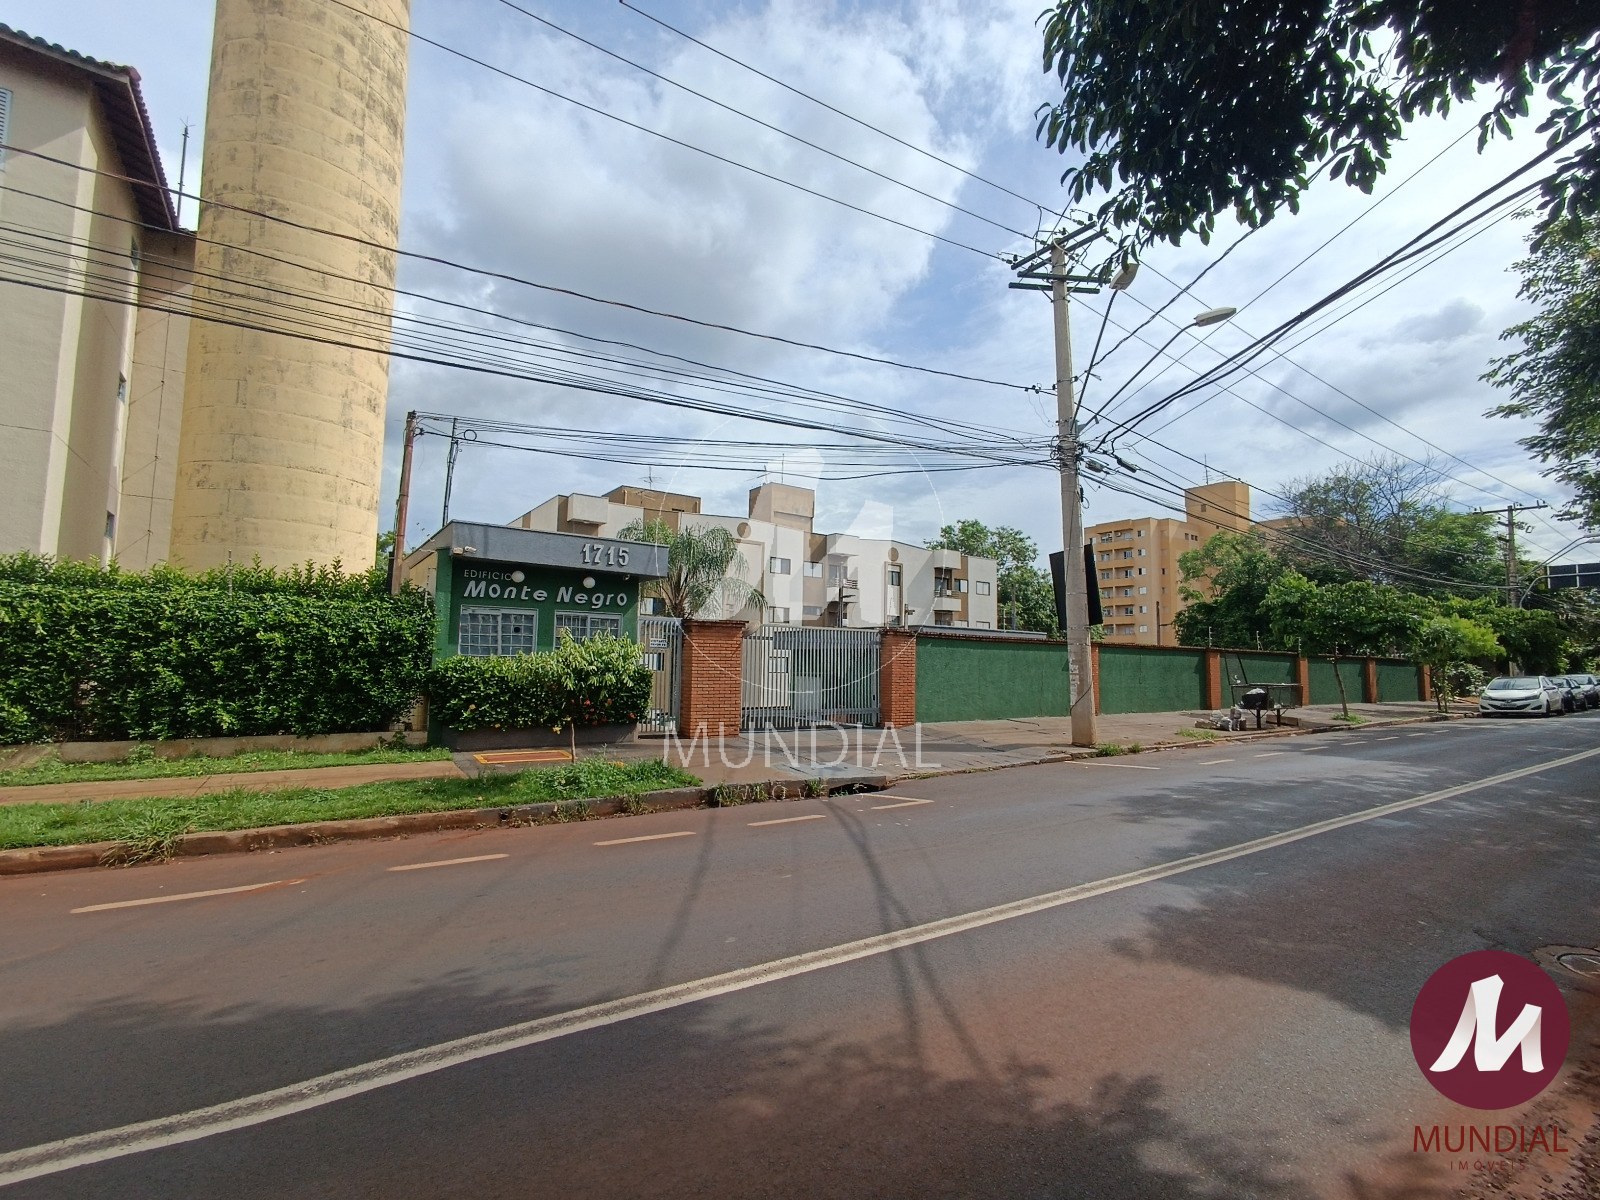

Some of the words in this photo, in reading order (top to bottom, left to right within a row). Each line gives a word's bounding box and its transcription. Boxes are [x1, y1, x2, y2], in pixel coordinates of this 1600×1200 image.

[582, 543, 629, 566] 1715
[464, 569, 512, 581] EDIFICIO
[464, 580, 548, 601] Monte
[556, 586, 628, 609] Negro
